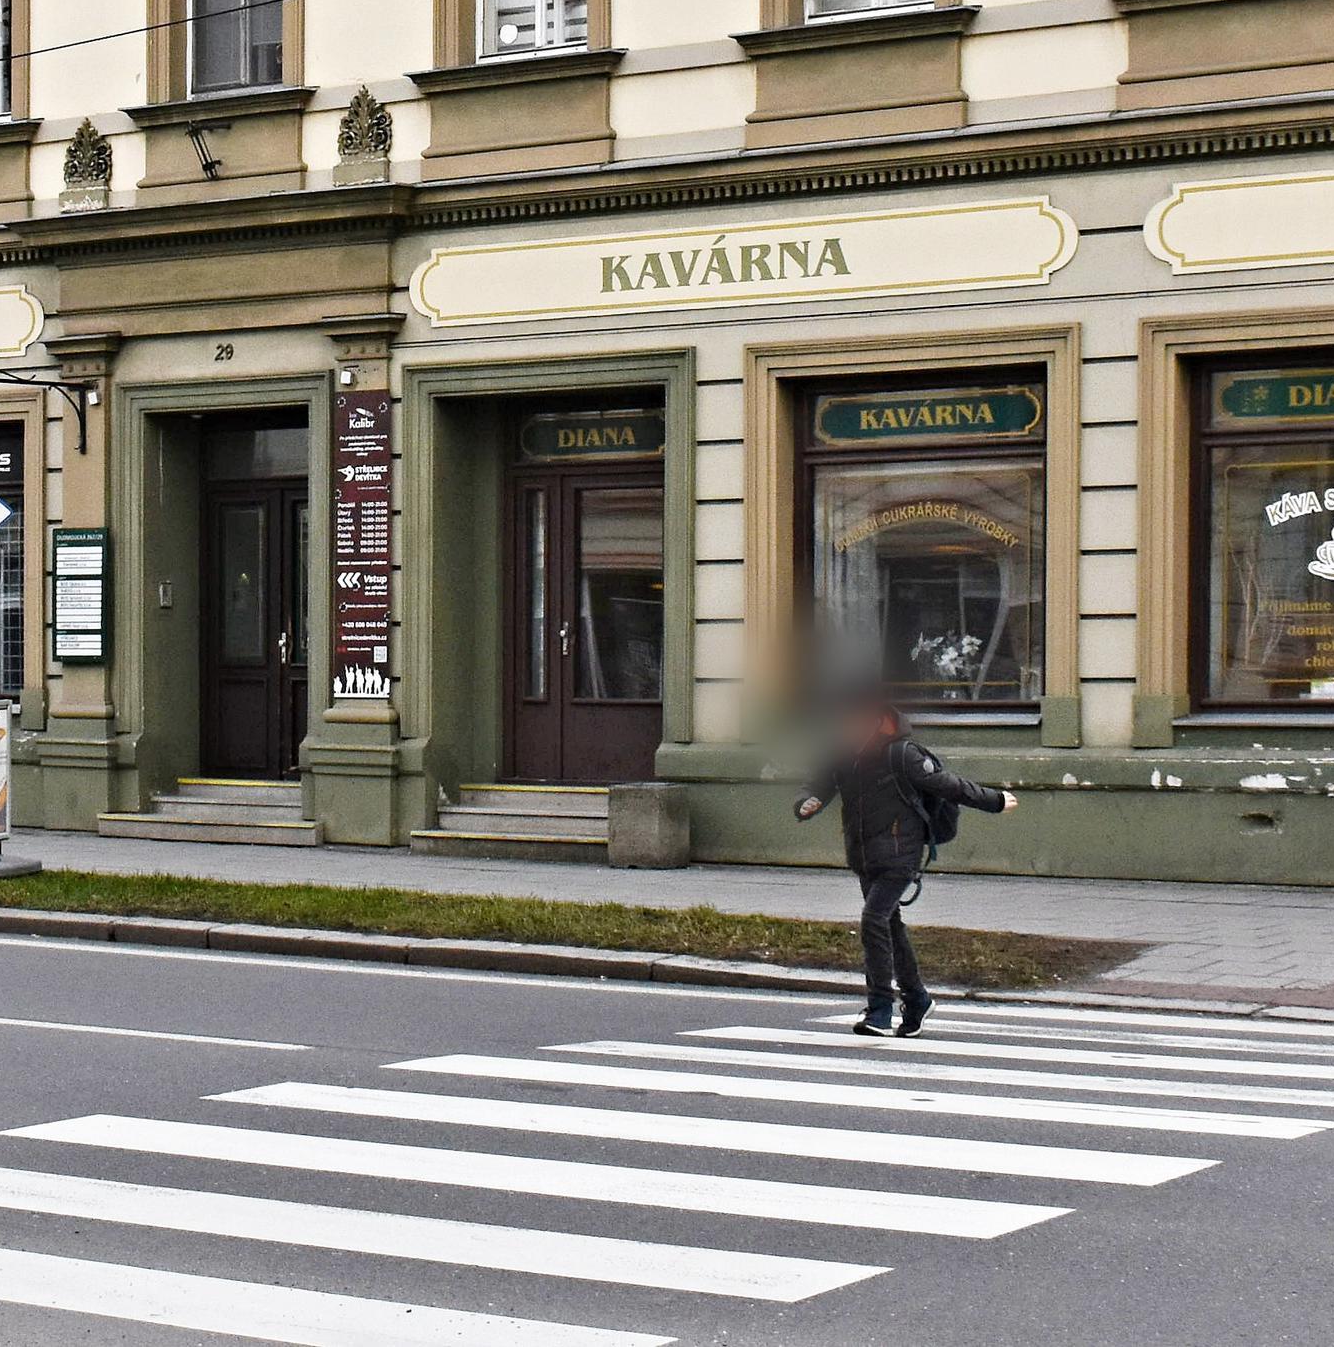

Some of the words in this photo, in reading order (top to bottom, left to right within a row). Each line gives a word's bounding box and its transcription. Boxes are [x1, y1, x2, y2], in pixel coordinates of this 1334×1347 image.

[599, 235, 851, 293] KAVÁRNA
[215, 343, 234, 361] 29
[859, 400, 994, 430] KAVÁRNA
[558, 425, 636, 447] DIANA
[1266, 490, 1322, 526] KÁVA
[882, 502, 958, 525] CUKRÁŘSKÉ
[964, 513, 1019, 548] VÝROBKY
